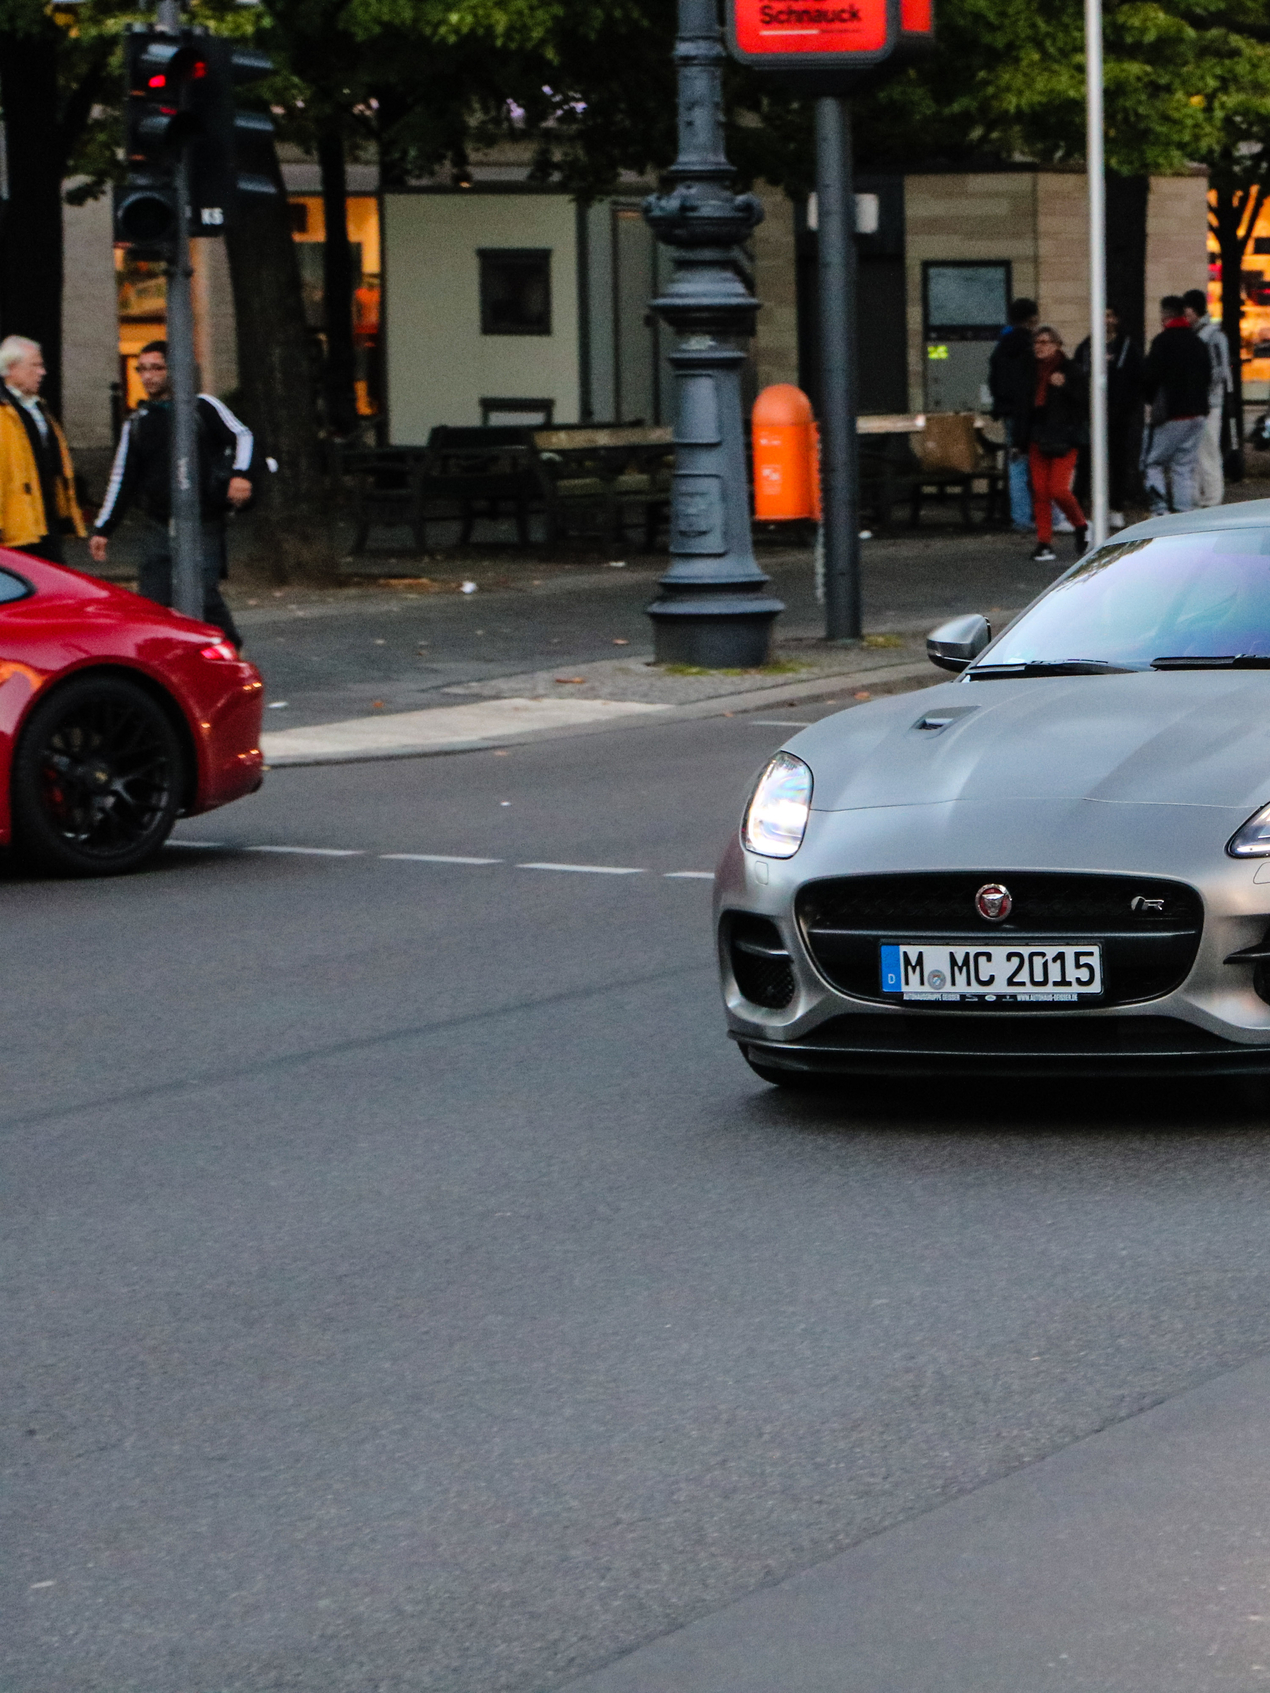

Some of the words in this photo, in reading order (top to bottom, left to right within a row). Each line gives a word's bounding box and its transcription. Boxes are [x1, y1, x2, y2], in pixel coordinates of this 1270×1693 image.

[759, 4, 862, 24] Schnauck
[887, 973, 896, 984] D
[902, 950, 925, 987] M
[949, 950, 996, 988] MC
[1005, 950, 1096, 988] 2015
